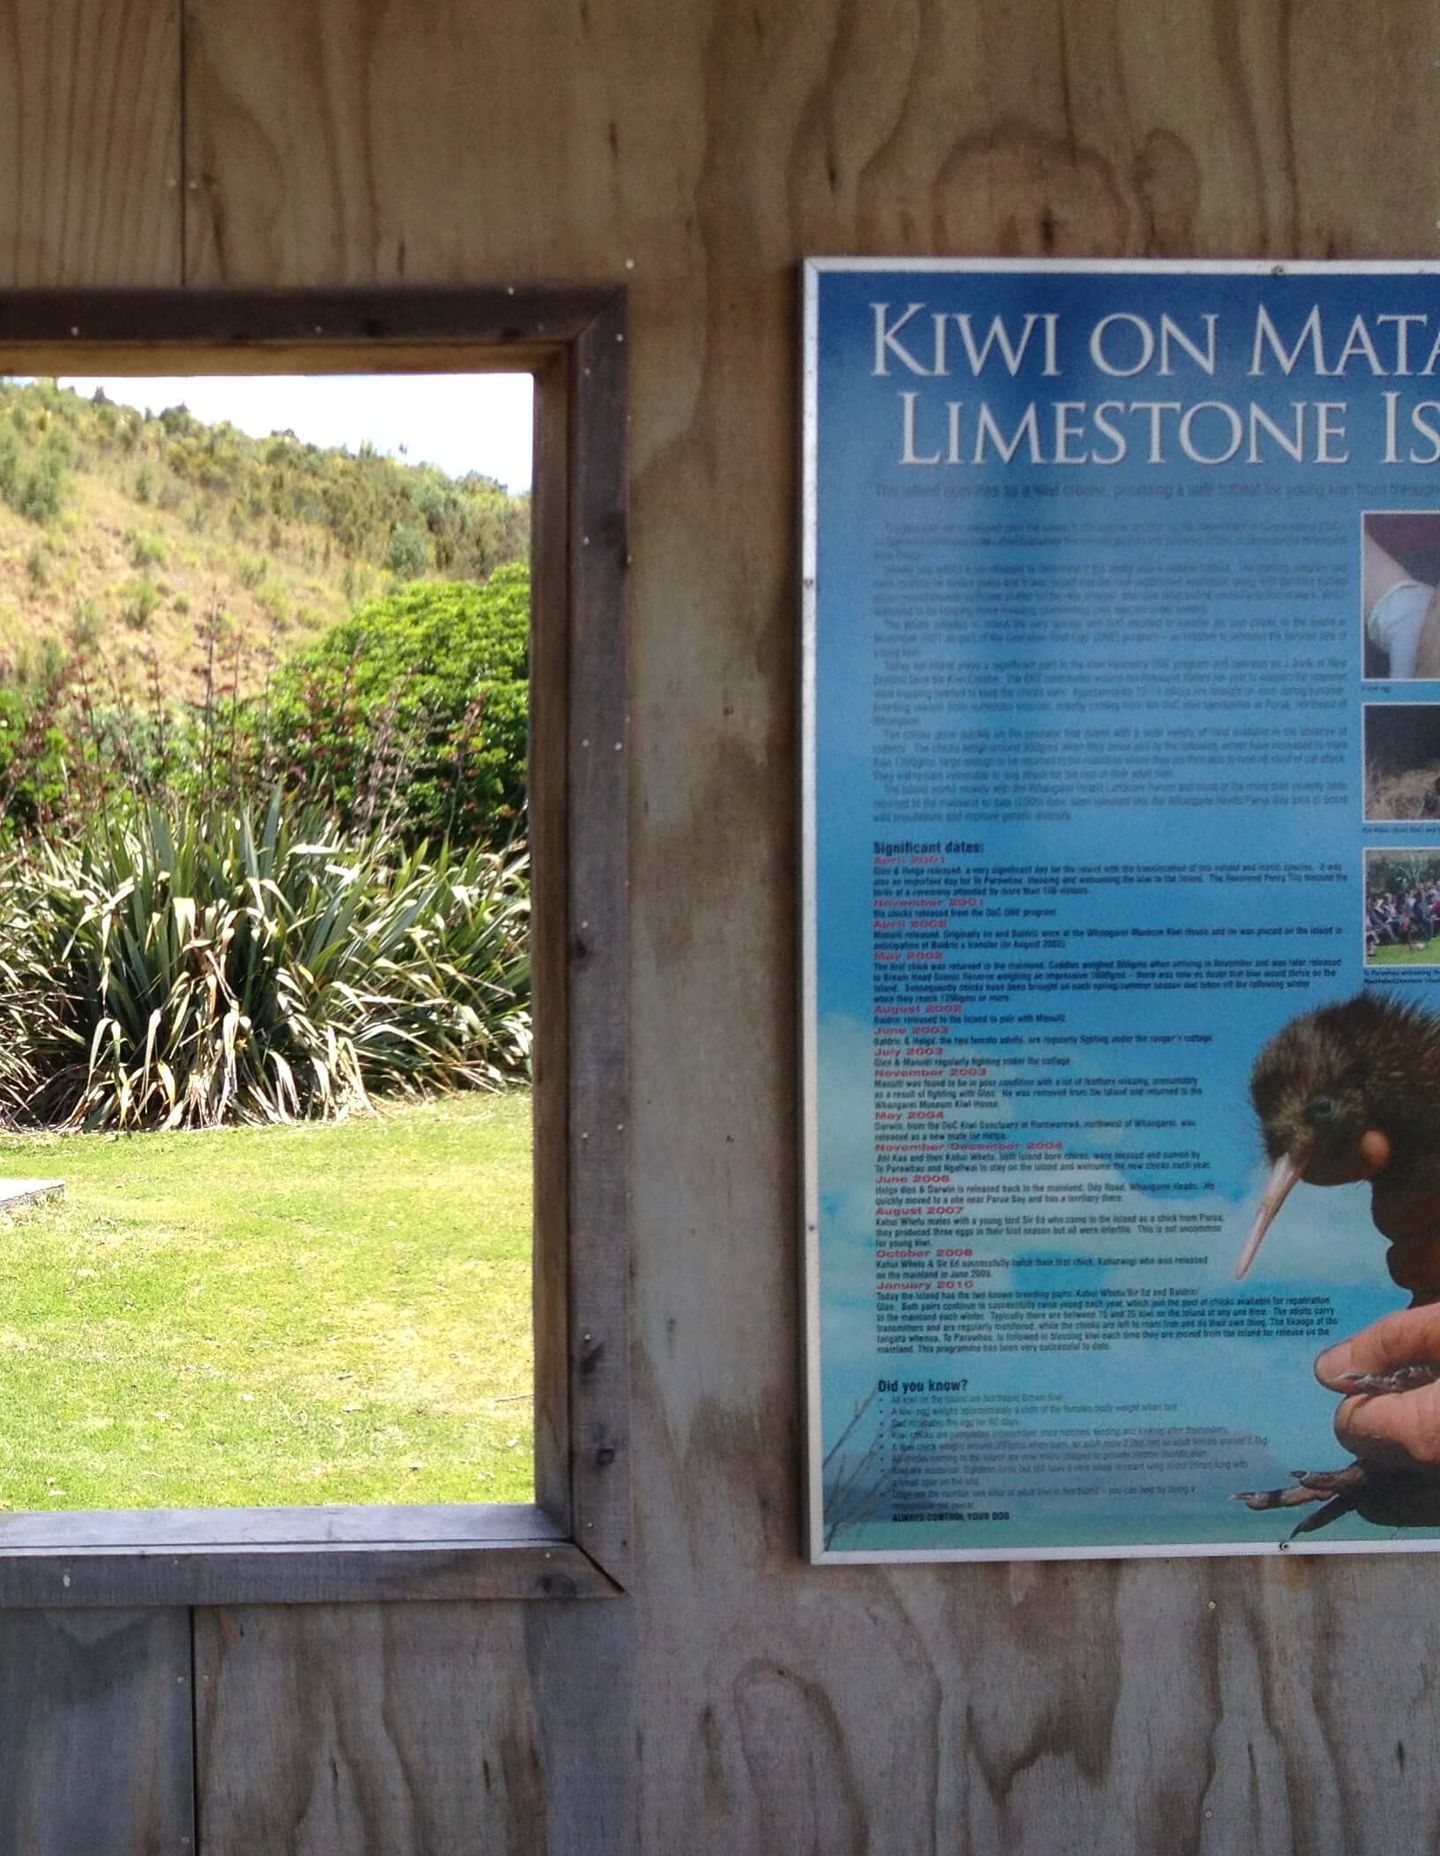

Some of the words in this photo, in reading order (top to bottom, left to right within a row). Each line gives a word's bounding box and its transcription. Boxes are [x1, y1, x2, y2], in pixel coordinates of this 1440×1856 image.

[868, 302, 1062, 377] KIWI
[1088, 312, 1219, 376] ON
[897, 391, 1352, 466] LIMESTONE
[873, 842, 941, 856] Significant
[945, 842, 985, 854] dates:
[874, 1068, 944, 1077] November
[948, 1067, 987, 1077] 2003
[874, 1111, 901, 1120] May
[906, 1110, 944, 1120] 2004
[876, 1174, 908, 1184] June
[875, 1206, 923, 1216] August
[926, 1205, 963, 1215] 2007
[876, 1249, 931, 1258] October
[878, 1281, 931, 1290] January
[936, 1280, 974, 1290] 2010
[878, 1380, 898, 1392] Did
[902, 1382, 924, 1394] you
[927, 1379, 968, 1392] know?
